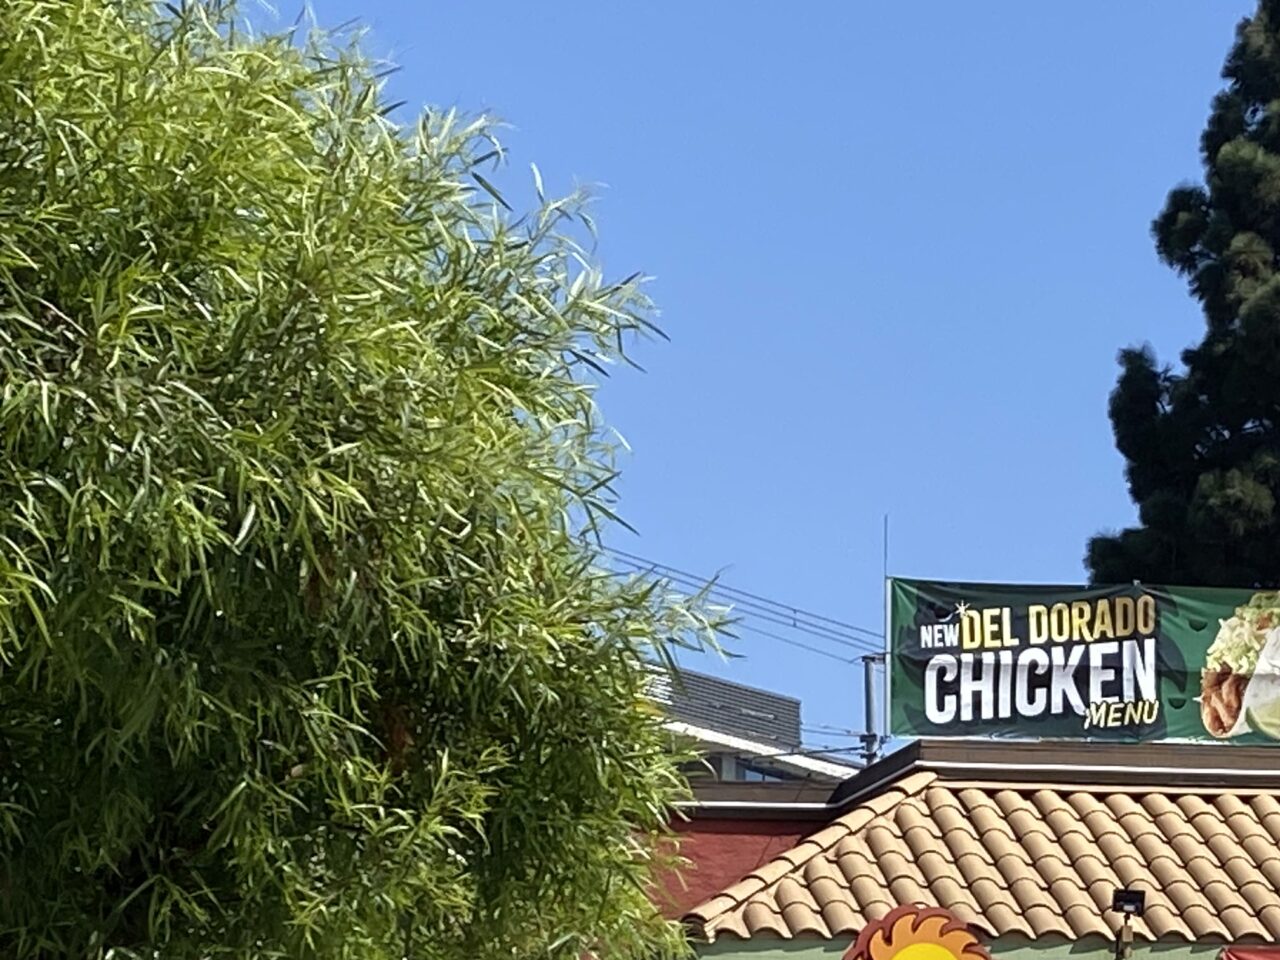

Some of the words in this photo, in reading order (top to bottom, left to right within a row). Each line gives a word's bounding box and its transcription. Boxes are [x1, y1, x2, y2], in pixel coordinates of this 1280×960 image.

[920, 622, 959, 649] NEW
[961, 607, 1020, 650] DEL
[1028, 594, 1156, 644] DORADO
[924, 638, 1158, 725] CHICKEN
[1084, 699, 1160, 730] MENU
